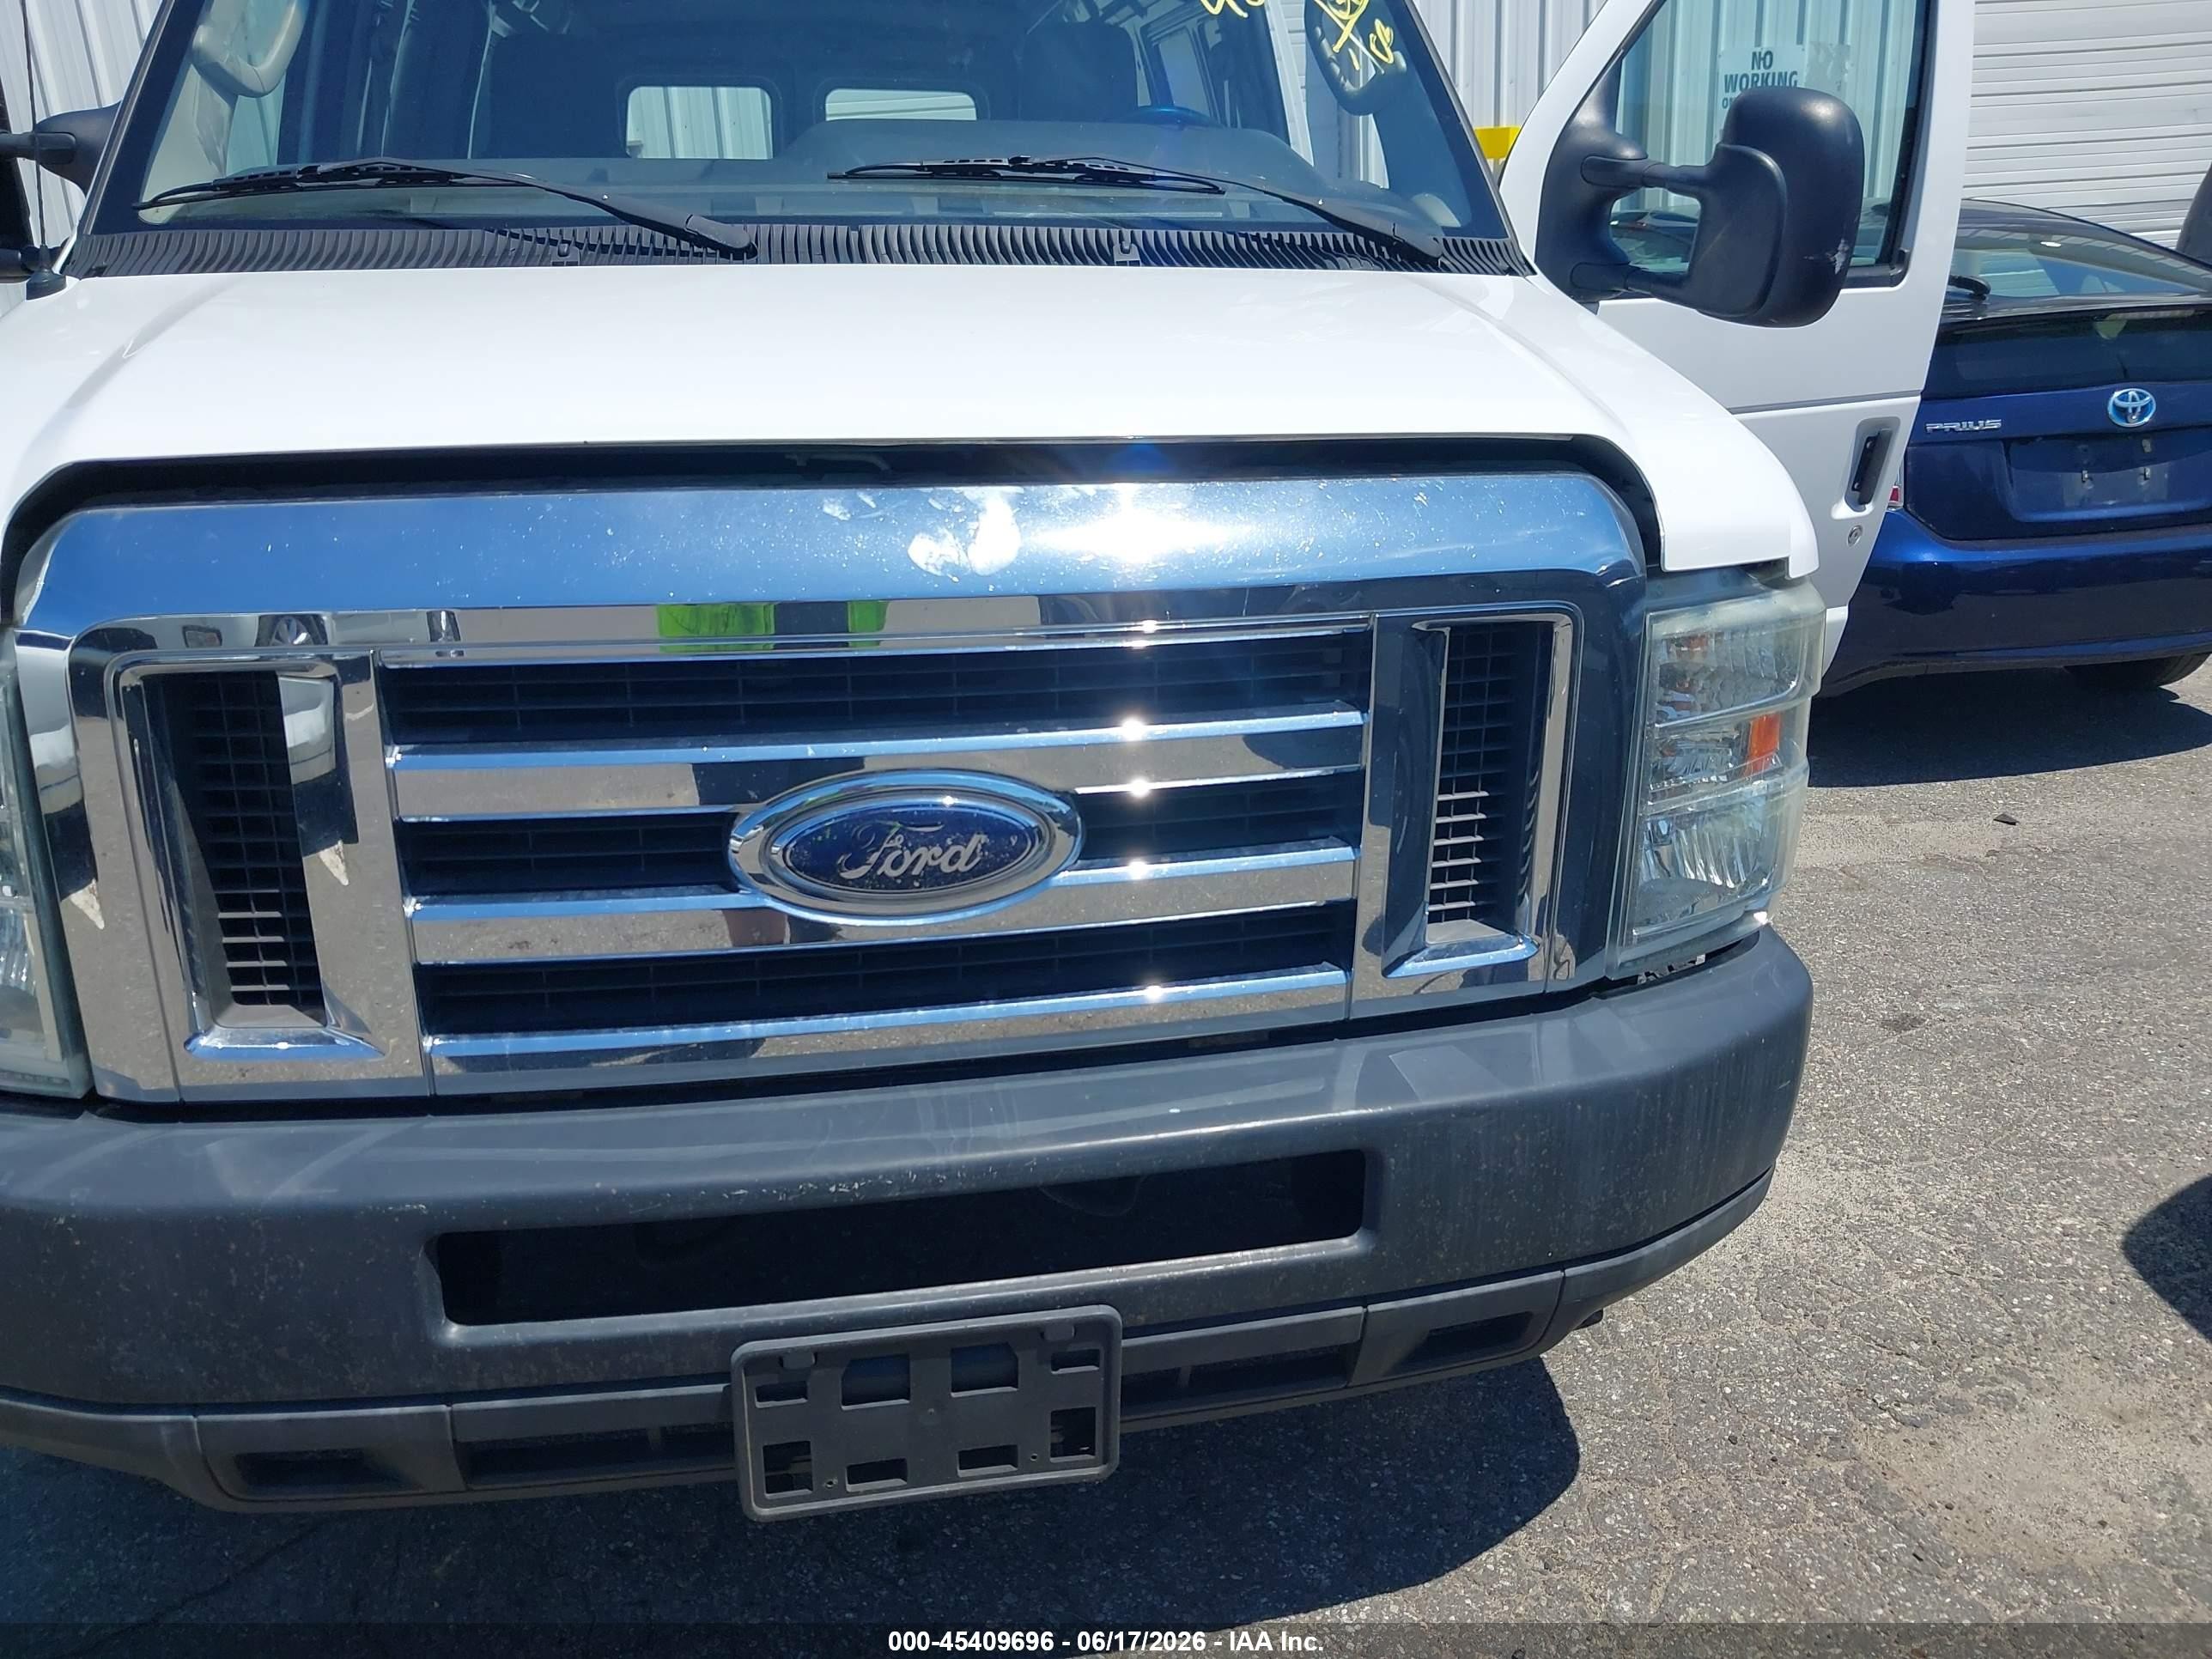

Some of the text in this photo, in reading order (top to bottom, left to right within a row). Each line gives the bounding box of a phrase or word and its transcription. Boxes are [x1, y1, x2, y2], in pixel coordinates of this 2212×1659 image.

[1751, 50, 1774, 71] NO
[1723, 70, 1799, 94] WORKING
[1925, 419, 2002, 433] PRIUS
[837, 820, 990, 879] Ford
